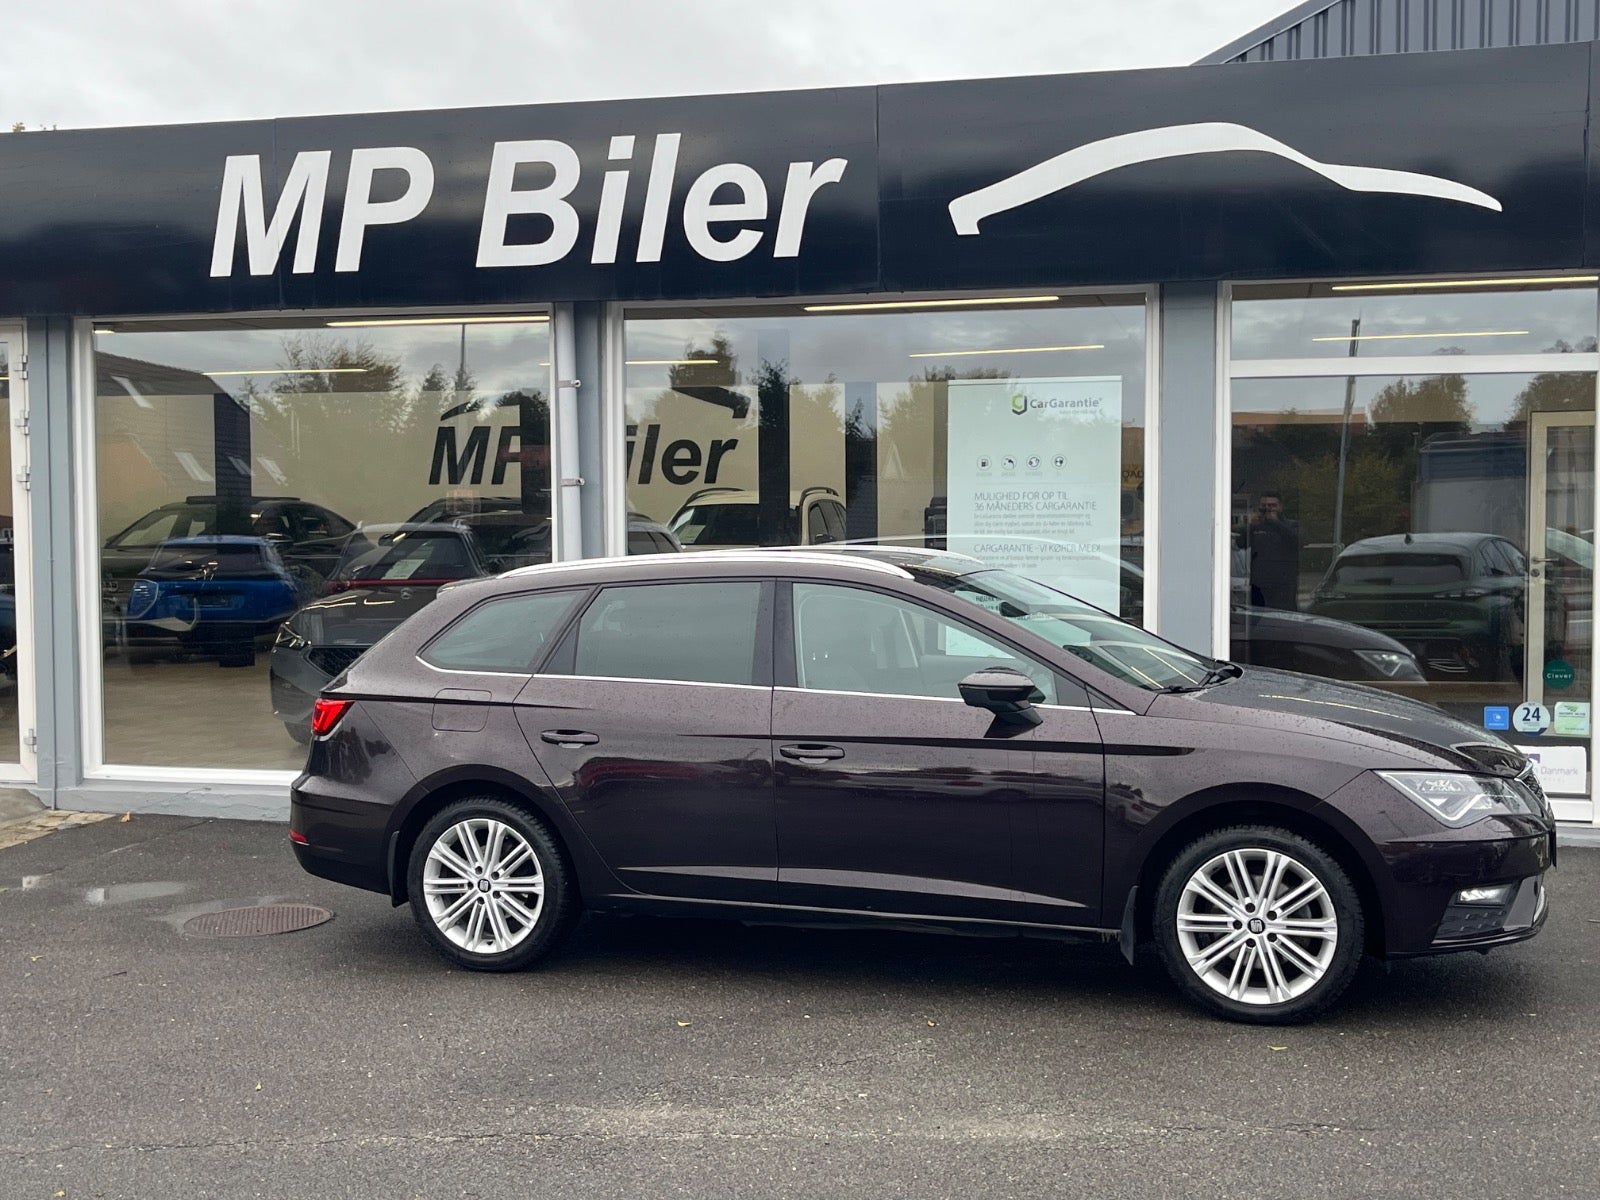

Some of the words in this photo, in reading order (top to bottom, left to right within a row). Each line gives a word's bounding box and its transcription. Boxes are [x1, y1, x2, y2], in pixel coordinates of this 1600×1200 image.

[210, 147, 434, 277] MP
[475, 133, 848, 268] Biler
[1029, 397, 1100, 409] CarGarantie
[626, 424, 739, 486] iler
[974, 491, 1020, 501] MULIGHED
[1022, 491, 1040, 501] FOR
[1041, 490, 1055, 501] OP
[1057, 490, 1069, 500] TIL
[974, 502, 985, 512] 36
[986, 500, 1034, 511] MÅNEDERS
[1035, 501, 1097, 511] CARGARANTIE
[973, 543, 1034, 553] CARGARANTIE
[1546, 672, 1572, 680] Clever
[1522, 707, 1541, 722] 24
[1540, 766, 1579, 775] Danmark
